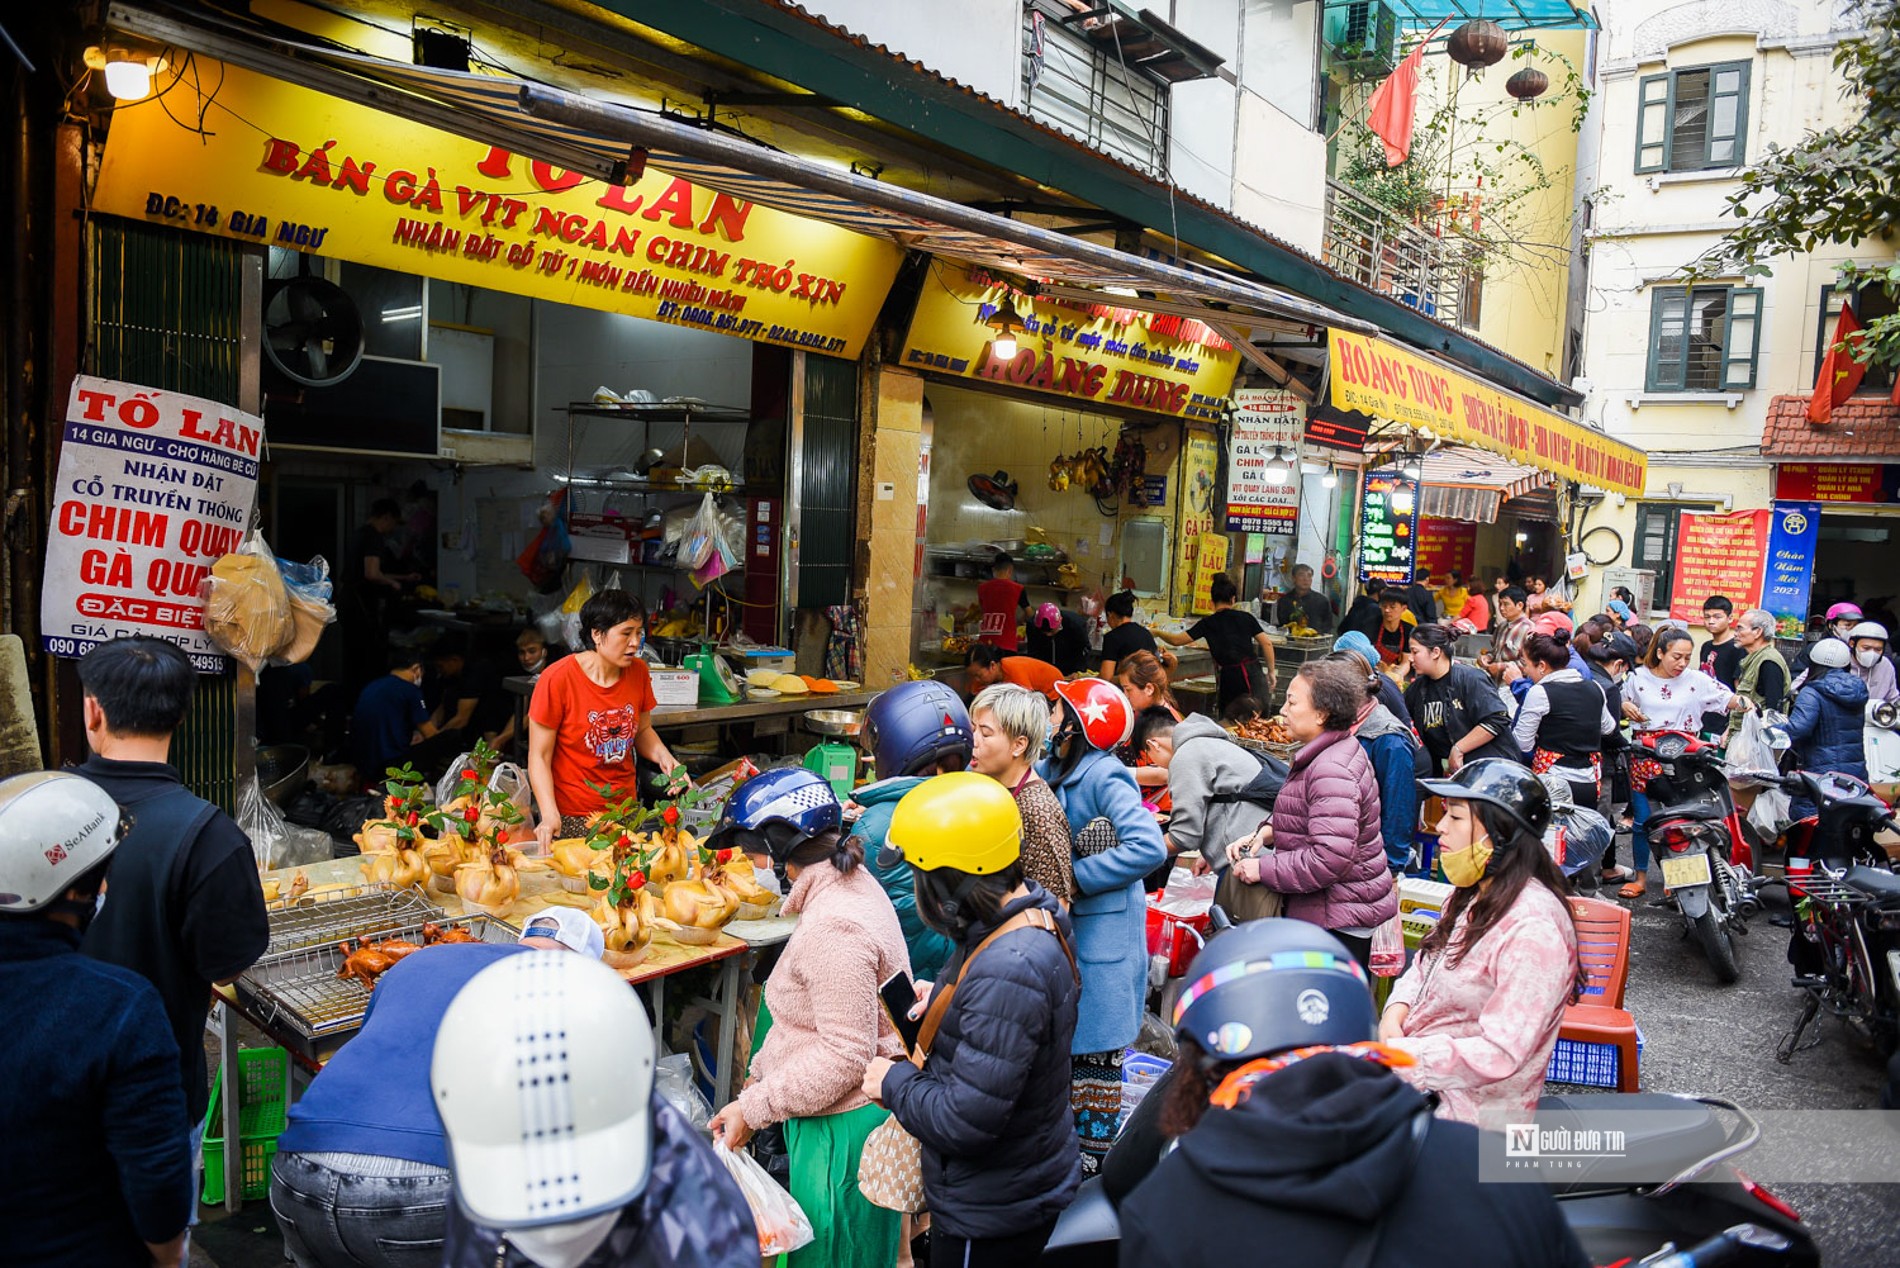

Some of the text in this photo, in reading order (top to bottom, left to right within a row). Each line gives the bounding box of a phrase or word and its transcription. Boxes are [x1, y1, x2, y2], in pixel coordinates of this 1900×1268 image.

[264, 138, 377, 196] BÁN
[384, 167, 443, 214] GÀ
[456, 186, 527, 229] VỊT
[532, 206, 641, 256] NGAN
[647, 235, 731, 277] CHIM
[597, 178, 754, 242] LAN
[146, 191, 328, 249] ĐC: 14 GIA NGƯ
[395, 217, 460, 251] NHẬN
[539, 248, 567, 274] TỪ
[567, 257, 579, 277] 1
[581, 259, 623, 287] MÓN
[624, 269, 659, 294] ĐẾN
[658, 278, 703, 304] NHIỀU
[658, 300, 680, 321] ĐT:
[1151, 312, 1181, 337] CHIM
[1060, 322, 1077, 341] từ
[1078, 330, 1103, 350] một
[1105, 338, 1128, 356] món
[981, 340, 1108, 397] HOÀNG
[1111, 369, 1190, 413] DUNG
[1338, 338, 1452, 415] HOÀNG DUNG
[1252, 394, 1277, 402] HOÀNG
[1360, 393, 1368, 404] 14
[1369, 395, 1379, 408] Gia
[78, 389, 260, 456] TỐ LAN
[1238, 415, 1270, 427] NHẬN
[71, 427, 88, 441] 14
[92, 430, 117, 446] GIA
[122, 435, 155, 452] NGƯ
[167, 442, 198, 462] CHỢ
[201, 444, 231, 468] HÀNG
[245, 460, 257, 477] CŨ
[1236, 444, 1250, 454] GÀ
[1236, 458, 1265, 467] CHIM
[1838, 464, 1847, 474] LÝ
[123, 459, 224, 493] NHẬN ĐẶT
[1242, 470, 1256, 480] GÀ
[1817, 474, 1837, 482] QUẢN
[1838, 474, 1847, 483] LÝ
[1860, 476, 1871, 485] THỊ
[1232, 483, 1242, 493] VỊT
[1243, 484, 1260, 494] QUAY
[1281, 486, 1296, 495] SƠN
[1817, 482, 1862, 492] QUẢN LÝ NHÀ
[72, 474, 243, 523] CỖ TRUYỀN THỐNG
[1233, 494, 1246, 502] XÔI
[1249, 495, 1265, 503] CÁC
[1367, 493, 1384, 505] Gà
[1829, 492, 1851, 500] CHÍNH
[1367, 507, 1384, 521] Vịt
[58, 499, 243, 557] CHIM QUAY
[1186, 515, 1198, 536] GÀ
[1241, 523, 1261, 531] 0912
[1366, 522, 1392, 534] Chim
[1365, 536, 1394, 549] Ngan
[1776, 549, 1804, 560] Chào
[79, 547, 214, 600] GÀ QUA
[1774, 561, 1804, 572] Năm
[1775, 573, 1799, 584] Mới
[1772, 586, 1800, 595] 2023
[80, 595, 207, 628] ĐẶC BIỆT
[71, 620, 109, 638] GIÁ
[49, 638, 75, 655] 090
[186, 653, 224, 672] 649515
[64, 812, 106, 851] SeABank
